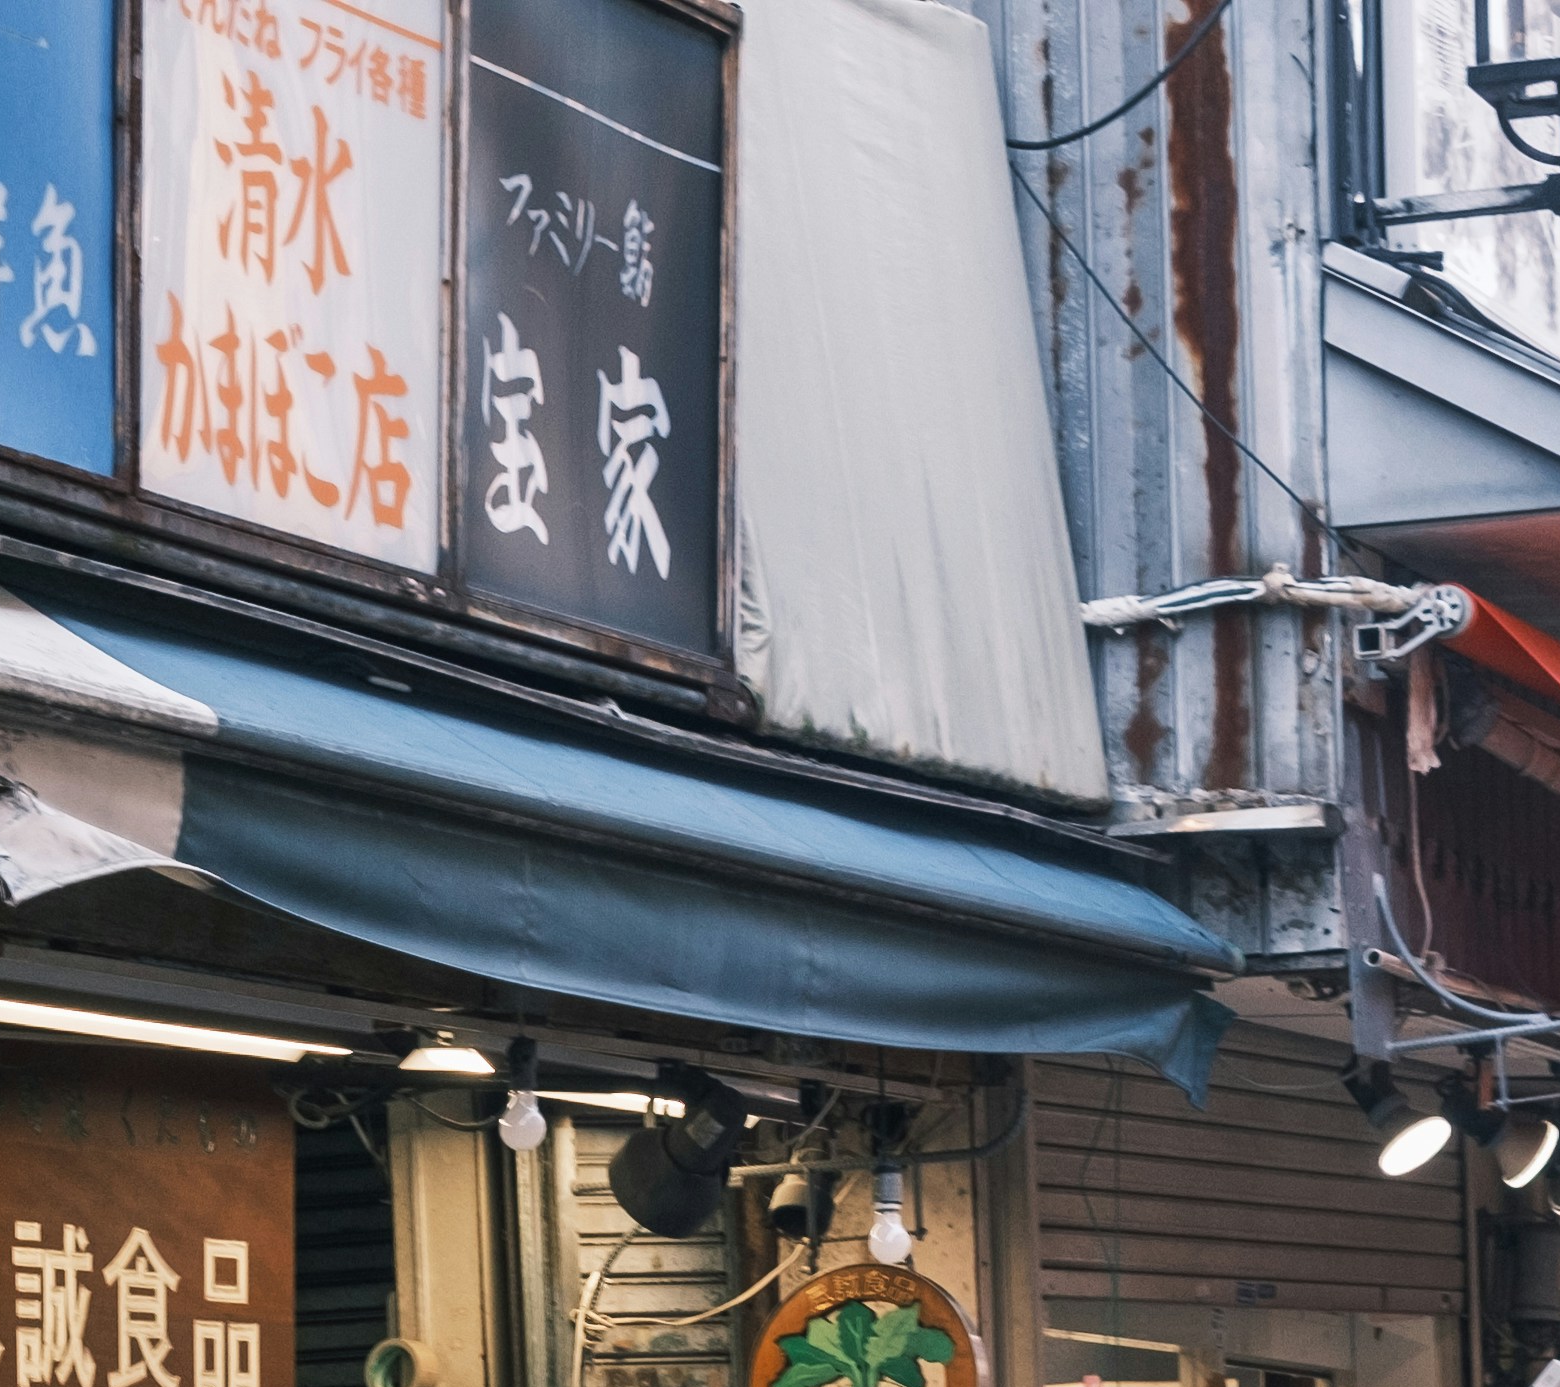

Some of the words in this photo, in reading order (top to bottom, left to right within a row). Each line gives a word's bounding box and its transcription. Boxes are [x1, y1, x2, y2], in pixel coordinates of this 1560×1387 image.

[215, 72, 354, 297] 清水
[156, 291, 413, 532] かまぼこ店
[480, 310, 673, 581] 宝家
